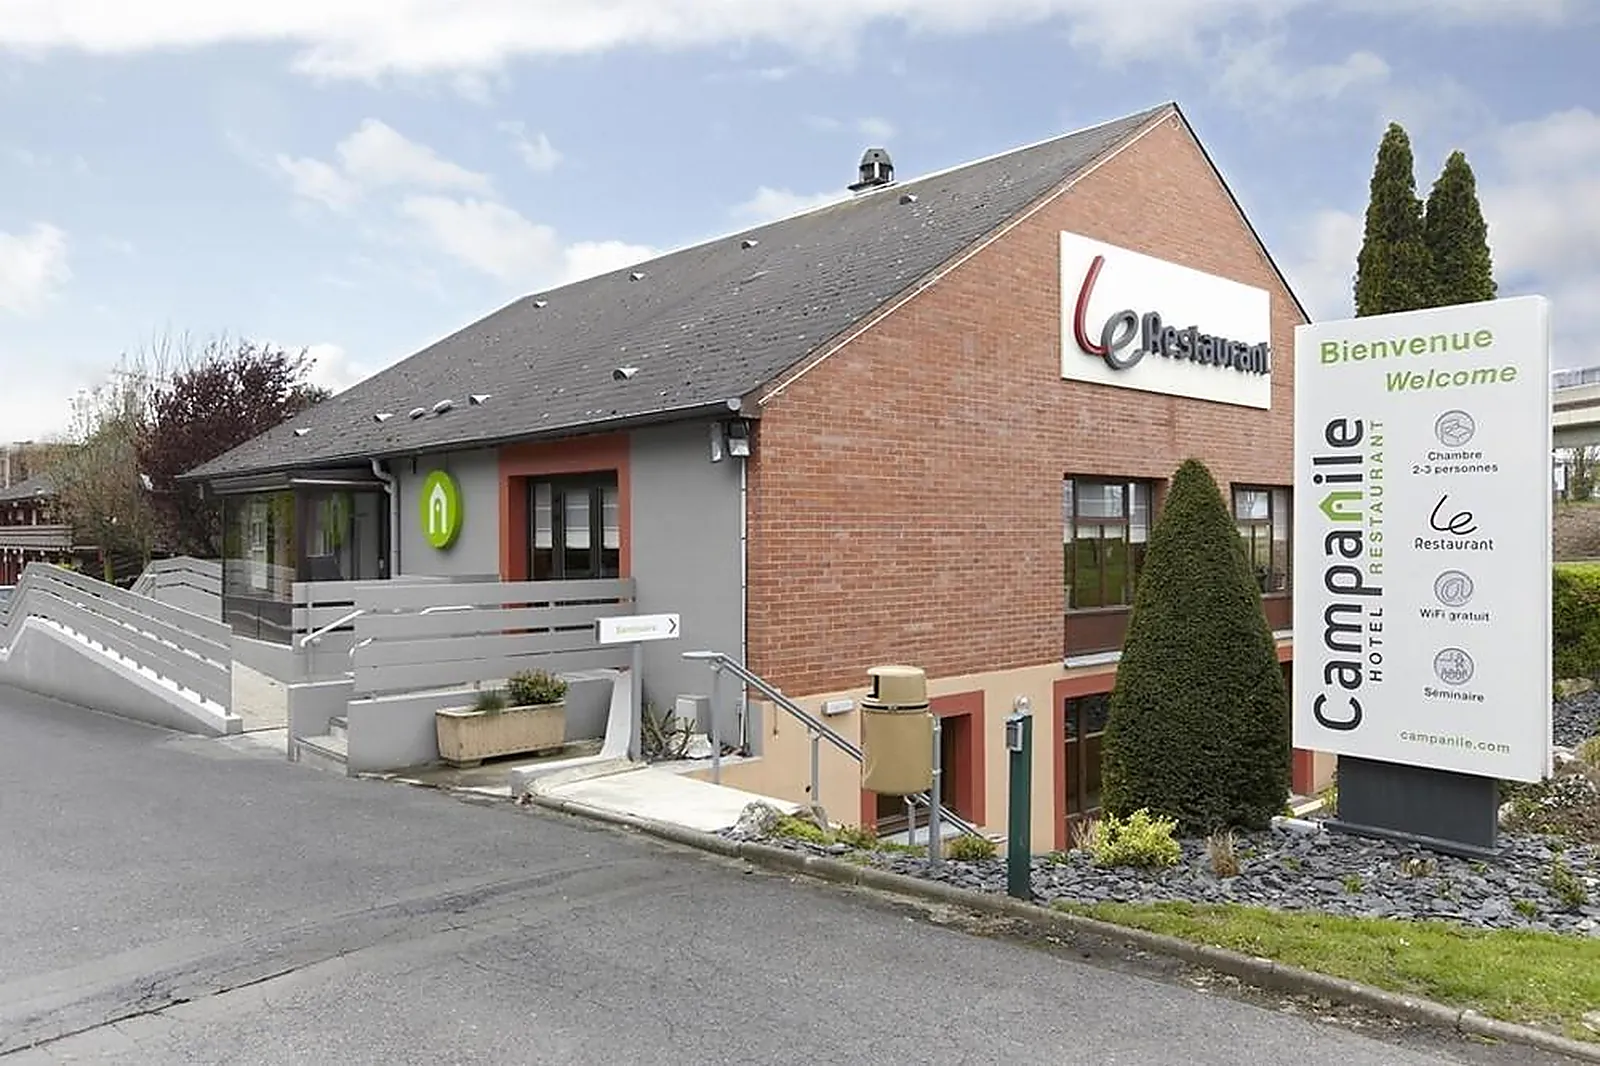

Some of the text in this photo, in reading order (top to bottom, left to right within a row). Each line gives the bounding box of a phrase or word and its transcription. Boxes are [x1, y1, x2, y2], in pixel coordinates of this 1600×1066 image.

[1074, 255, 1145, 370] Le
[1141, 311, 1271, 375] Restaurant
[1320, 329, 1494, 364] Bienvenue
[1385, 365, 1518, 392] Welcome
[1412, 464, 1498, 476] 2-3 personnes
[1427, 451, 1482, 461] Chambre
[1430, 494, 1478, 535] Le
[1369, 420, 1383, 682] HOTEL RESTAURANT
[1414, 537, 1494, 551] Restaurant
[1313, 418, 1383, 731] Campanile
[1419, 608, 1490, 623] WiFi gratuit
[1400, 731, 1510, 753] campanile.com
